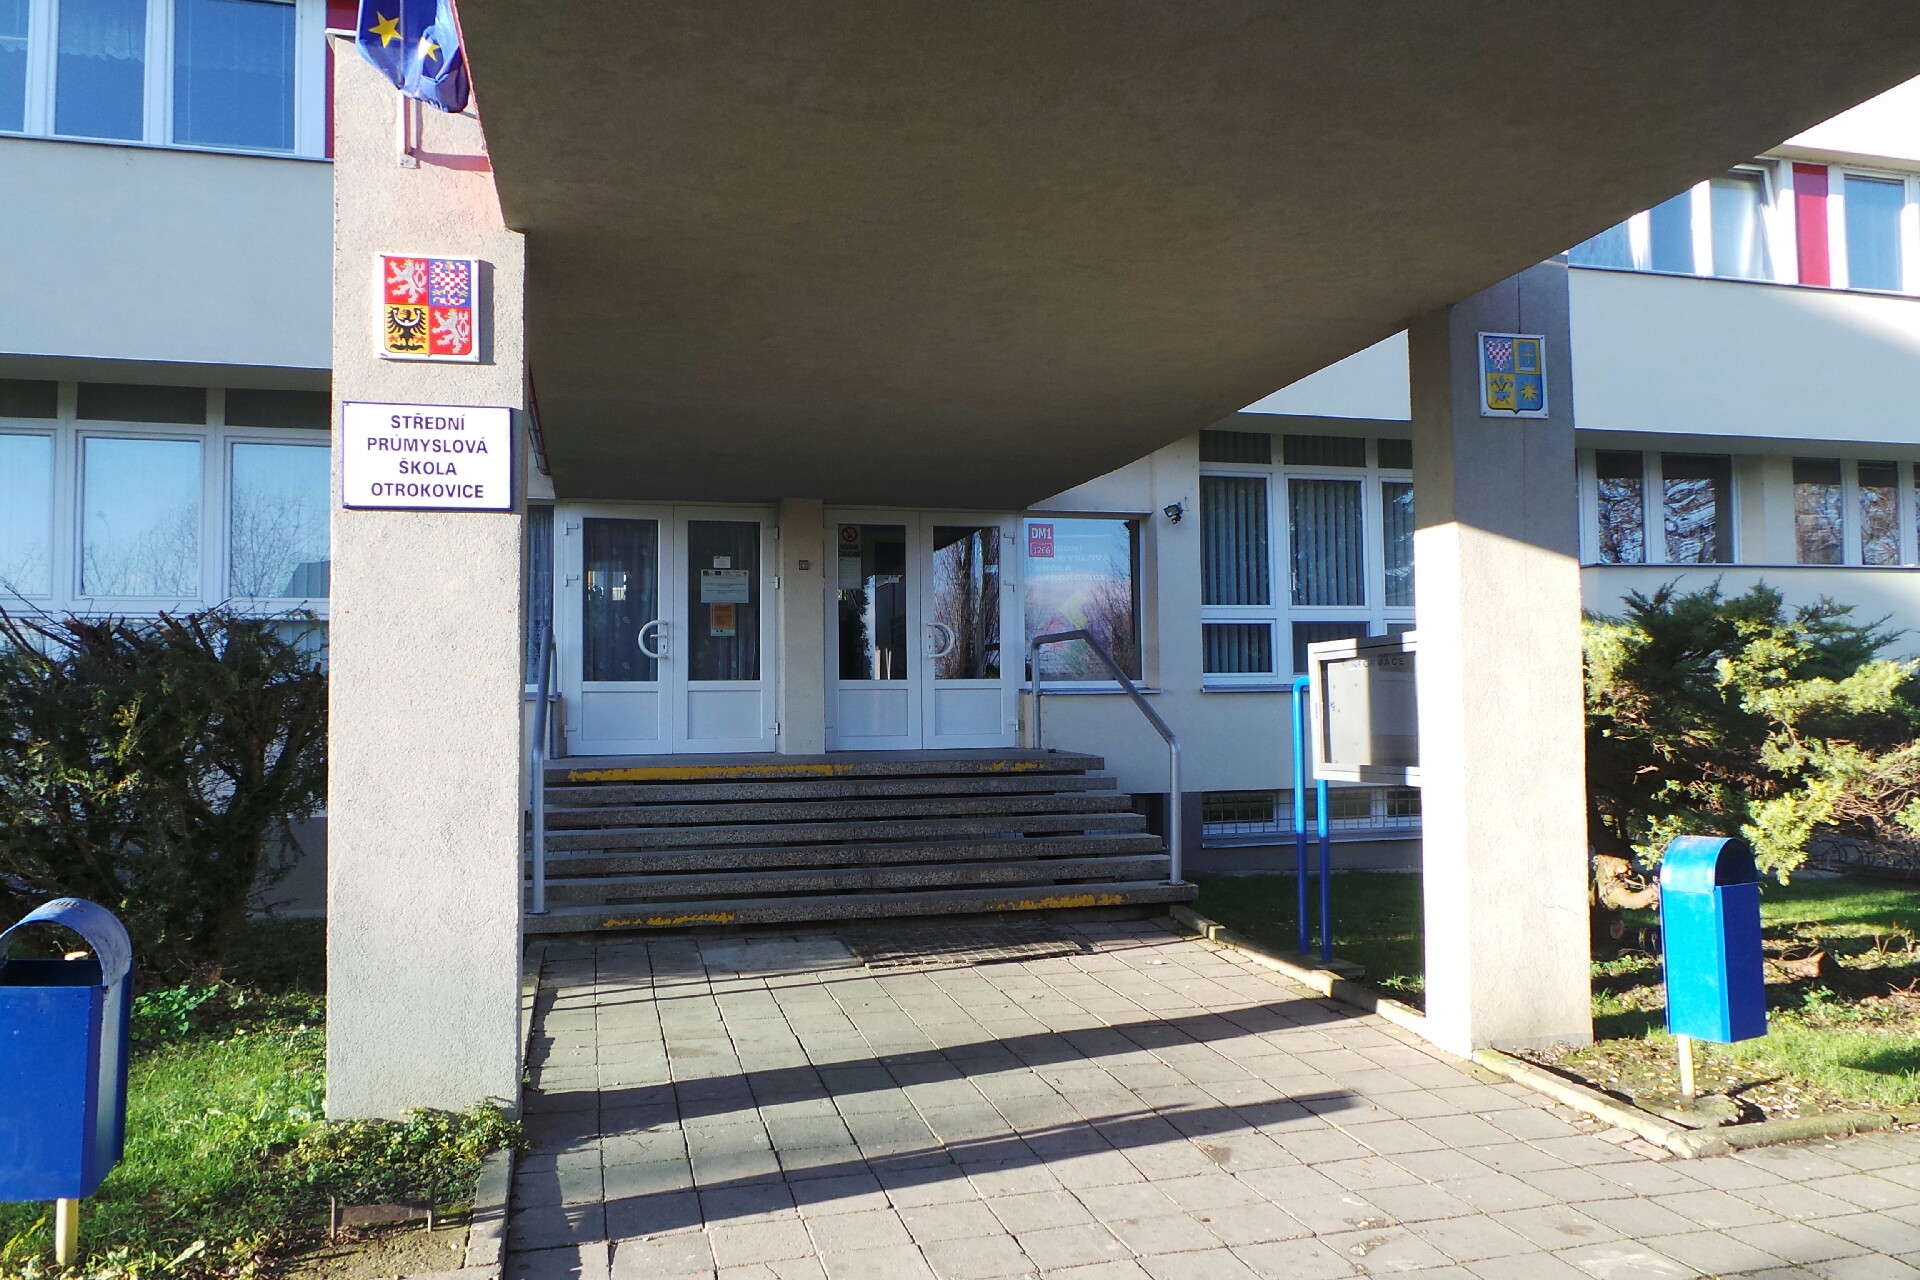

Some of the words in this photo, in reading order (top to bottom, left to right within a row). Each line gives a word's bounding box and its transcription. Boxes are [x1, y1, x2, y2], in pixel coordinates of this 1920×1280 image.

[390, 412, 466, 431] STŘEDNÍ
[367, 433, 489, 454] PRŮMYSLOVÁ
[399, 457, 458, 476] ŠKOLA
[370, 482, 485, 499] OTROKOVICE
[1031, 527, 1052, 540] DM1
